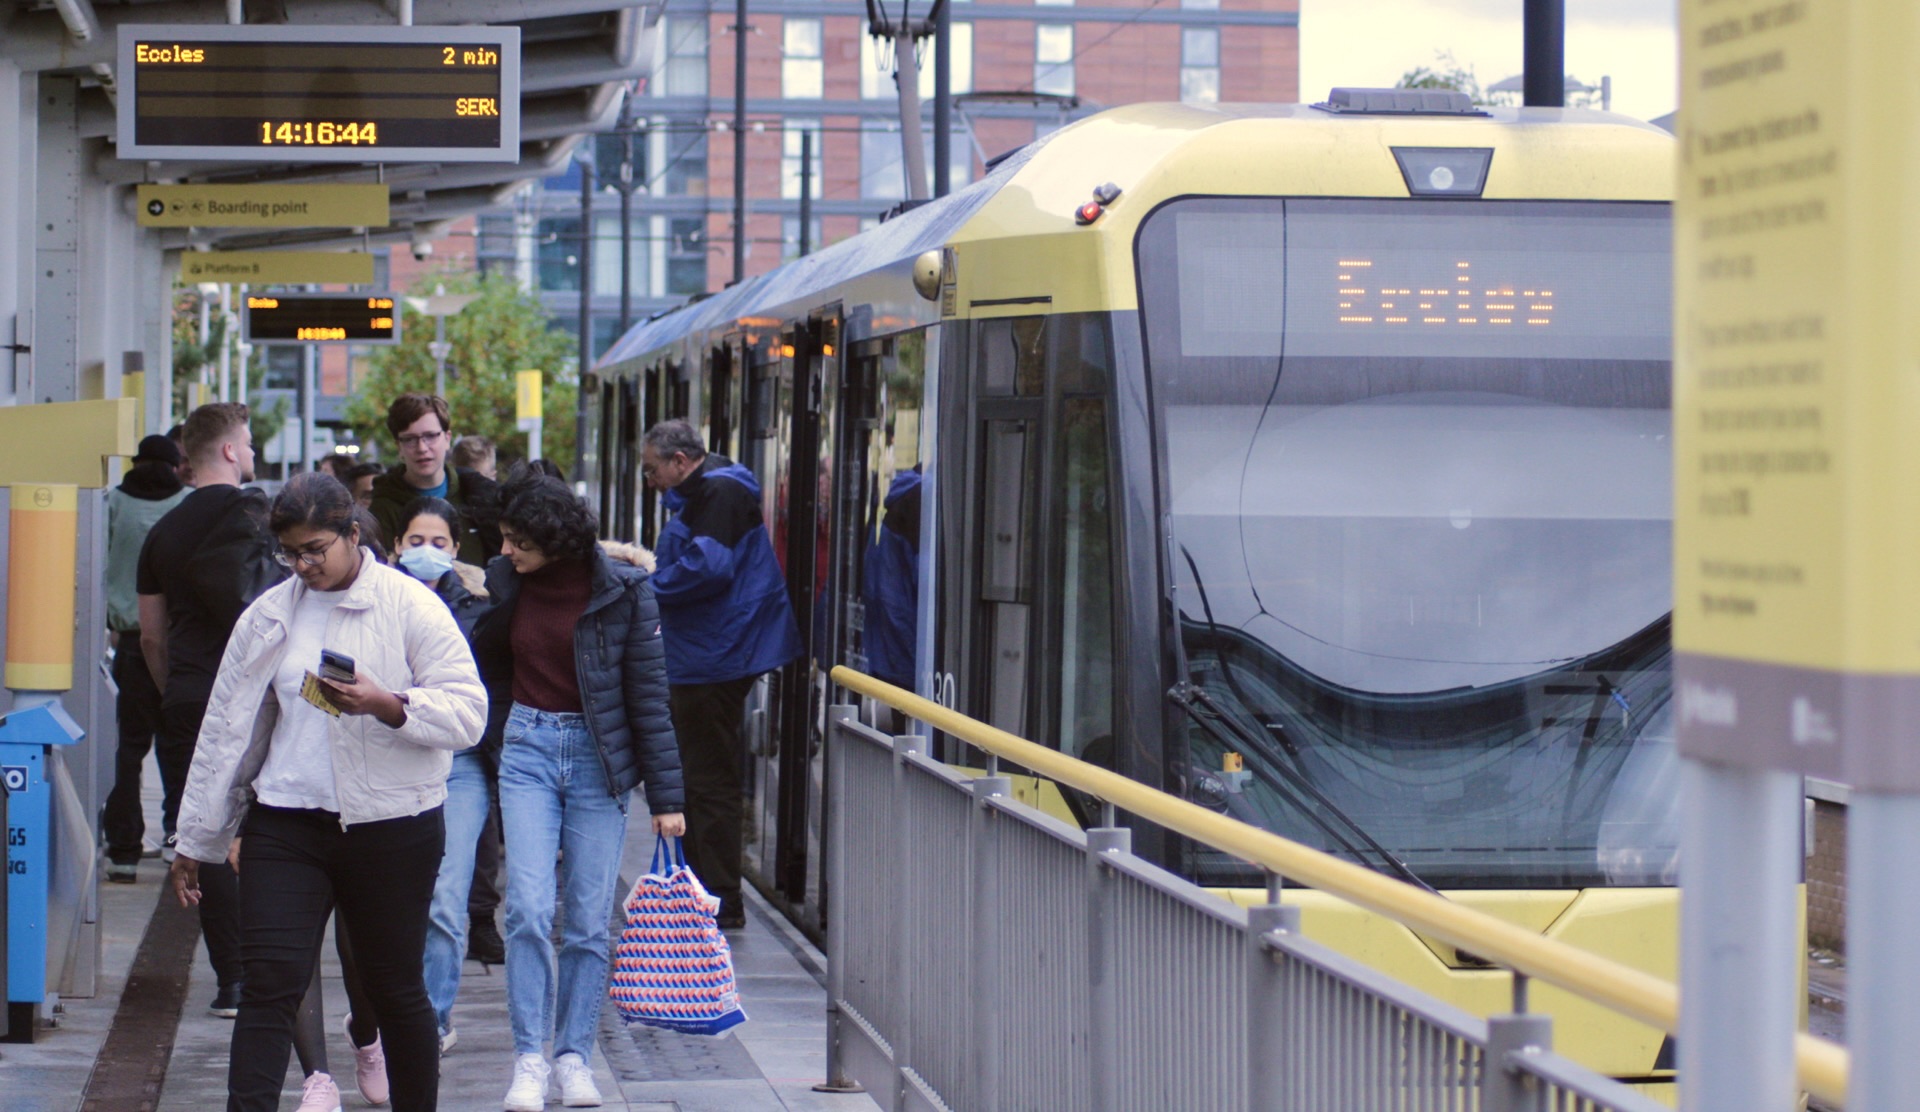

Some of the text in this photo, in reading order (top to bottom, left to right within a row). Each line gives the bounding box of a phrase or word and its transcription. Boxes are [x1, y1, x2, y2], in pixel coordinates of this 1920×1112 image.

[136, 44, 498, 65] Eccles 2 min
[262, 121, 377, 145] 14:16:44
[208, 200, 308, 218] Boarding point
[204, 263, 250, 274] Platform
[1338, 260, 1553, 324] Eccles
